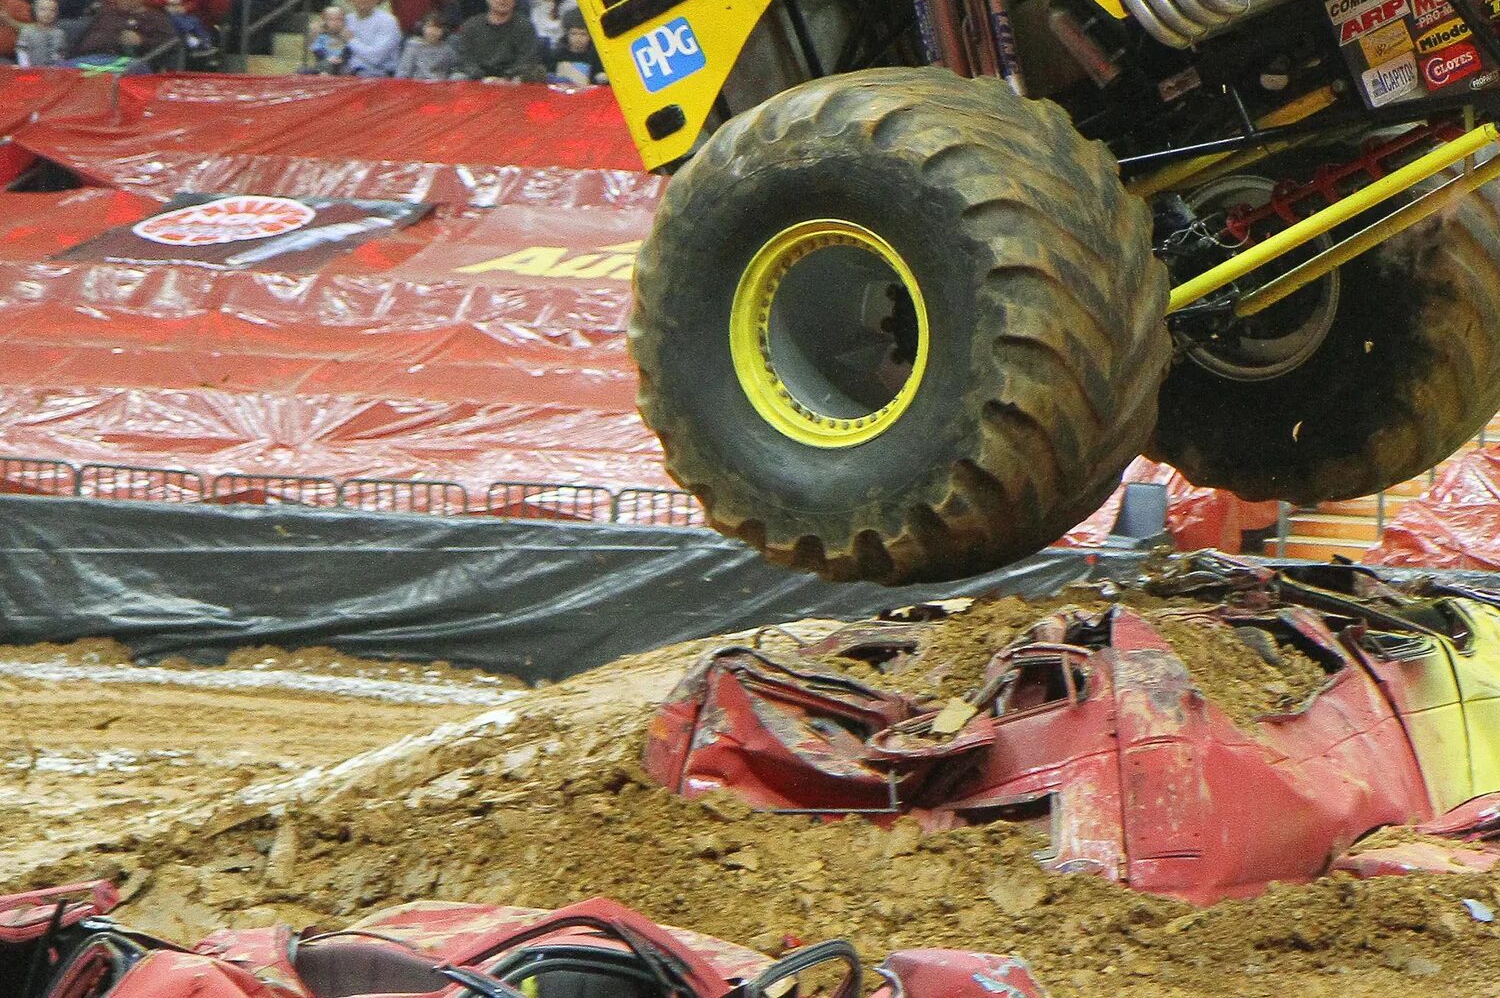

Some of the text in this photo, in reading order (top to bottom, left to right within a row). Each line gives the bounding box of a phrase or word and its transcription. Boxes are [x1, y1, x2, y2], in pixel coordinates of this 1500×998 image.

[1419, 22, 1469, 51] Milodo
[635, 24, 699, 79] PPG
[1433, 52, 1473, 75] CLOYES
